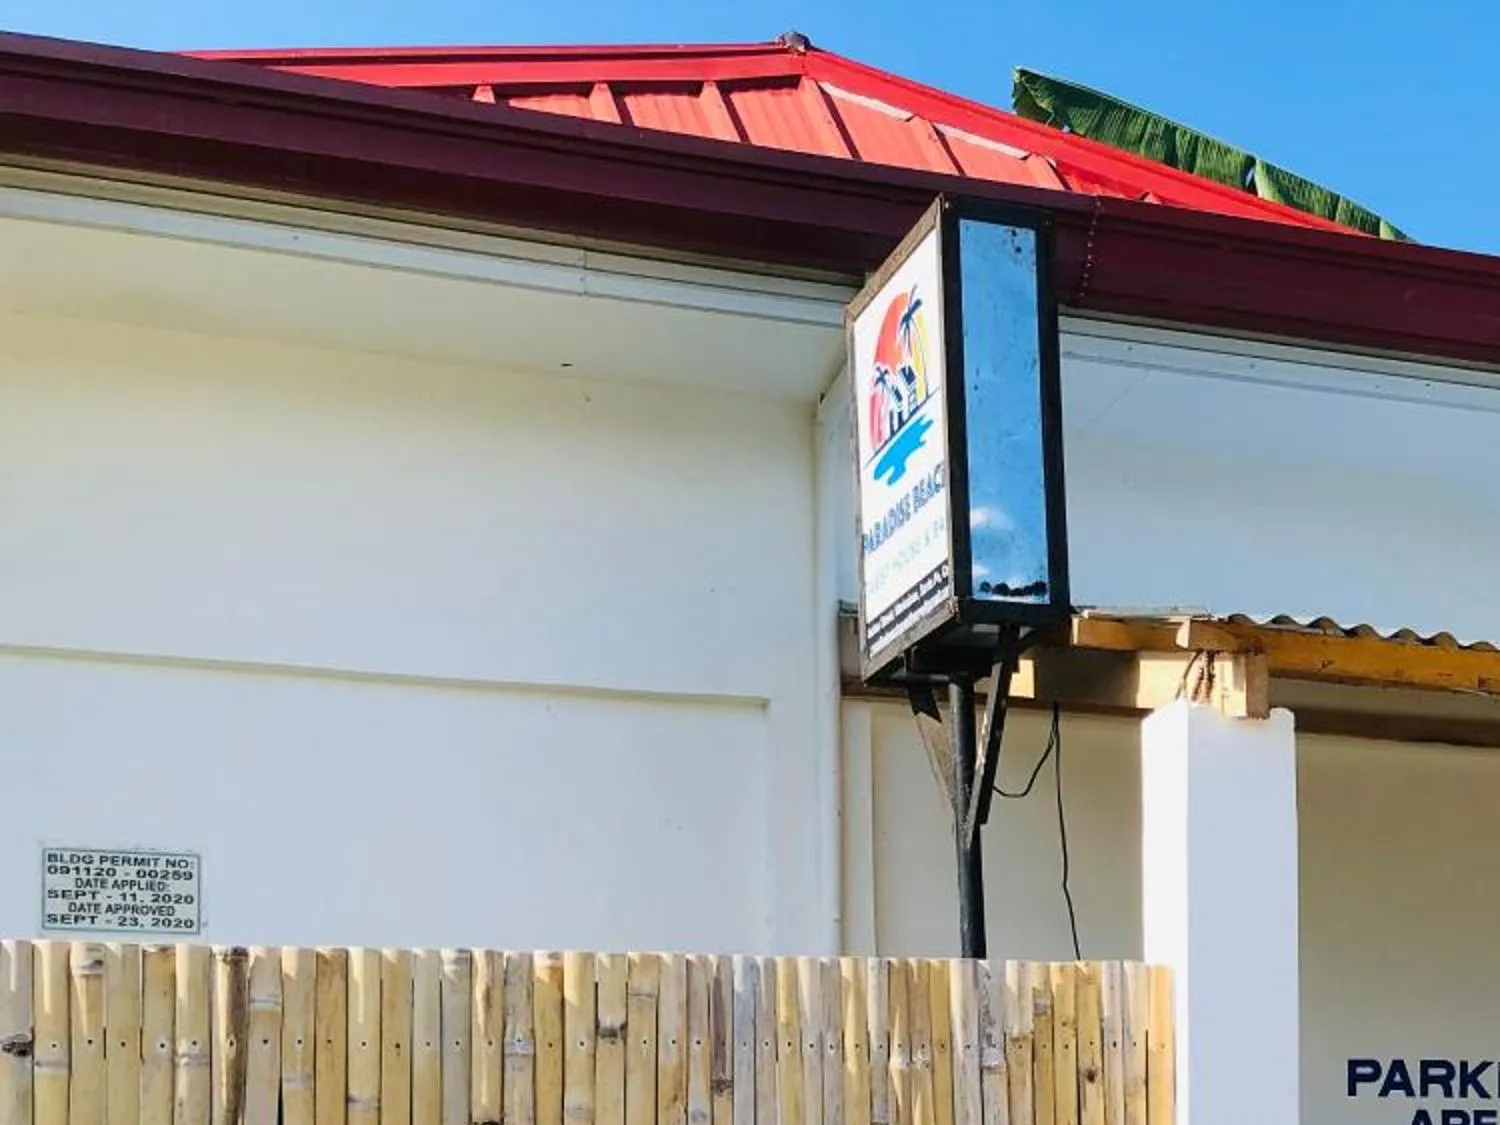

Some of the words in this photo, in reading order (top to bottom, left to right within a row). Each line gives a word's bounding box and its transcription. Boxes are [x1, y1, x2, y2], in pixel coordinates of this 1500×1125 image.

[47, 853, 95, 865] BLDG
[99, 855, 160, 867] PERMIT
[47, 865, 117, 877] 091120
[75, 877, 109, 889] DATE
[47, 889, 100, 900] SEPT
[151, 893, 194, 905] 2020
[68, 902, 101, 914] DATE
[105, 903, 175, 917] APPROVED
[47, 913, 99, 925] SEPT
[151, 917, 194, 929] 2020
